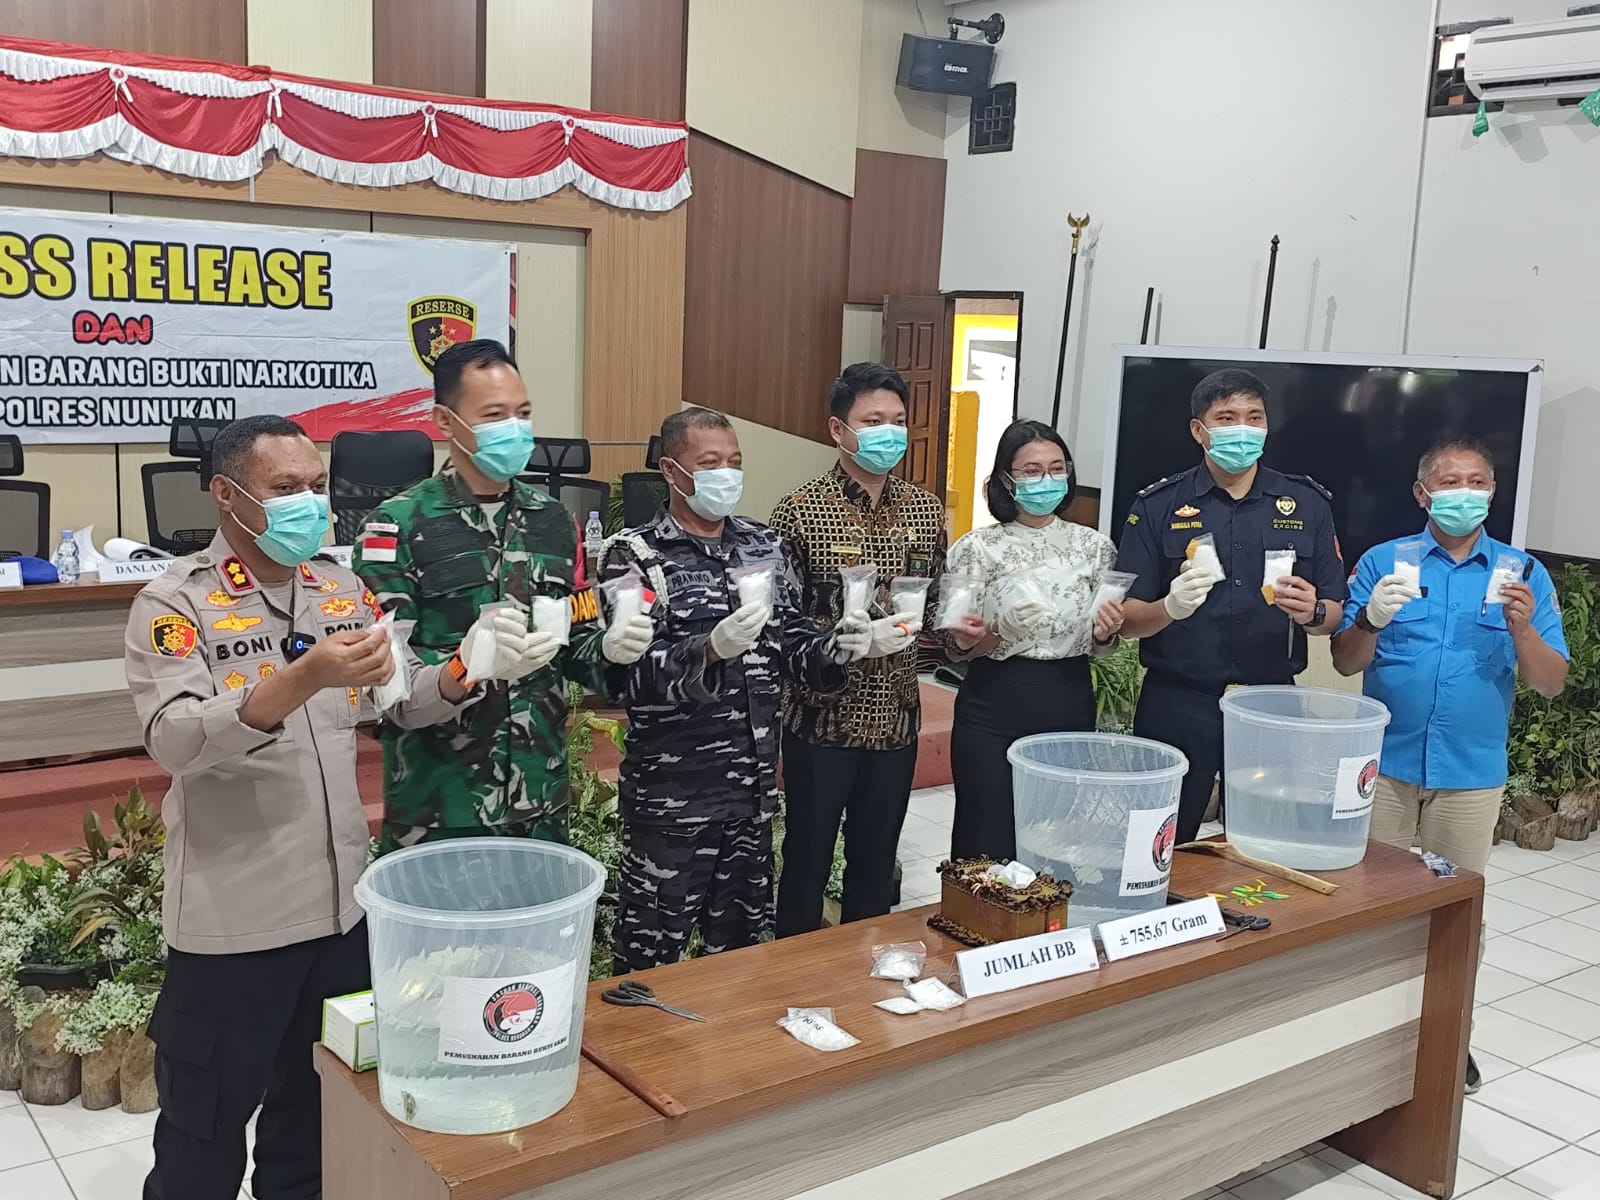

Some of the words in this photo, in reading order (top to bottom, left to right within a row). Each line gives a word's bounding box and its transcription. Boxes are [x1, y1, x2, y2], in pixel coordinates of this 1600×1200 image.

[88, 237, 333, 310] RELEASE
[415, 301, 470, 318] RESERSE
[72, 310, 153, 344] DAN
[26, 356, 147, 387] BARANG
[151, 358, 231, 387] BUKTI
[234, 359, 377, 388] NARKOTIKA
[100, 397, 236, 426] NUNUKAN
[216, 636, 272, 660] BONI
[1130, 921, 1168, 944] 755,67
[1171, 914, 1207, 932] Gram
[984, 946, 1052, 977] JUMLAH
[1053, 941, 1076, 959] BB
[501, 1049, 532, 1059] BARANG
